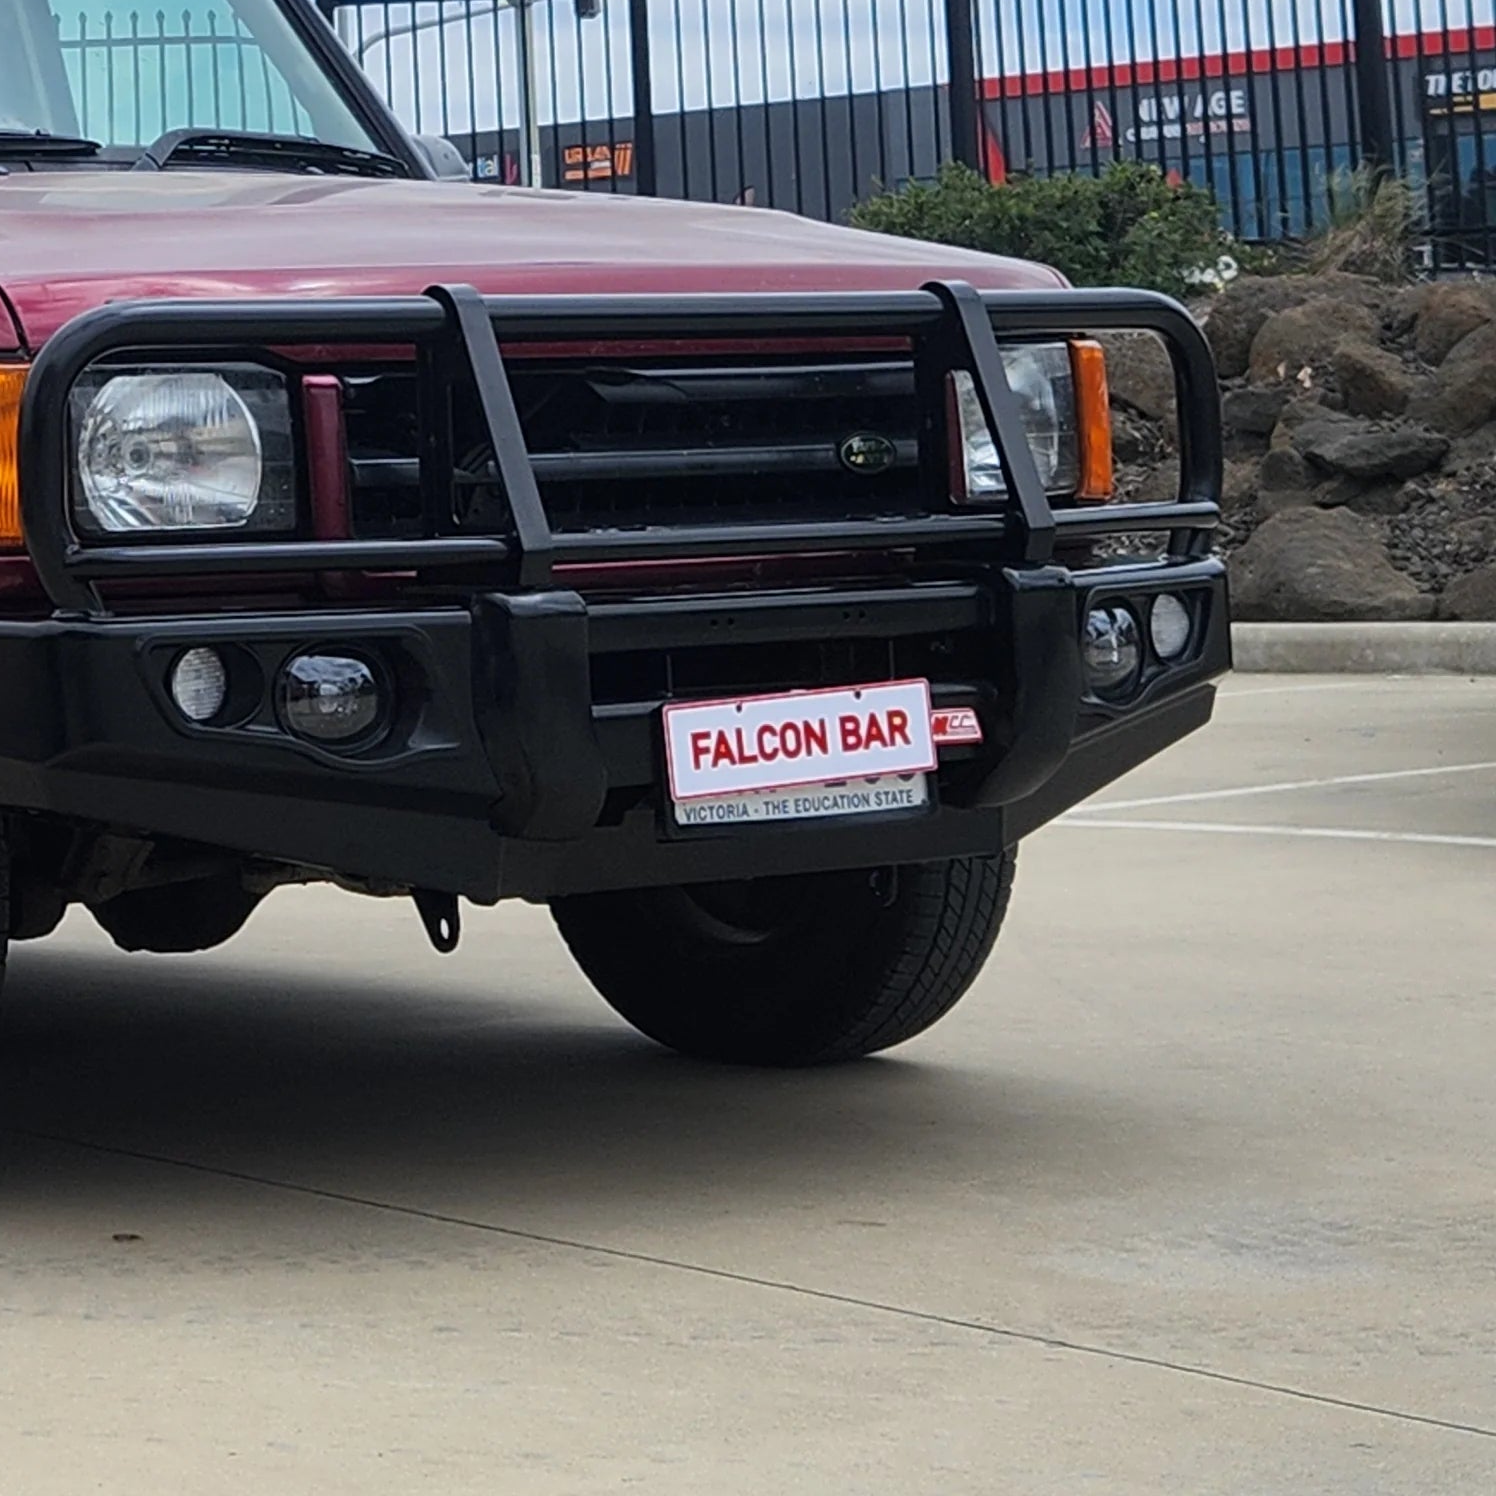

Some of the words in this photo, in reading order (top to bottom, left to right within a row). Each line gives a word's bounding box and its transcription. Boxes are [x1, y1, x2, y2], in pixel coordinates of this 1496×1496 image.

[690, 718, 829, 770] FALCON
[838, 709, 911, 752] BAR
[683, 802, 750, 822] VICTORIA
[762, 799, 790, 816] THE
[794, 793, 871, 814] EDUCATION
[874, 789, 913, 806] STATE
